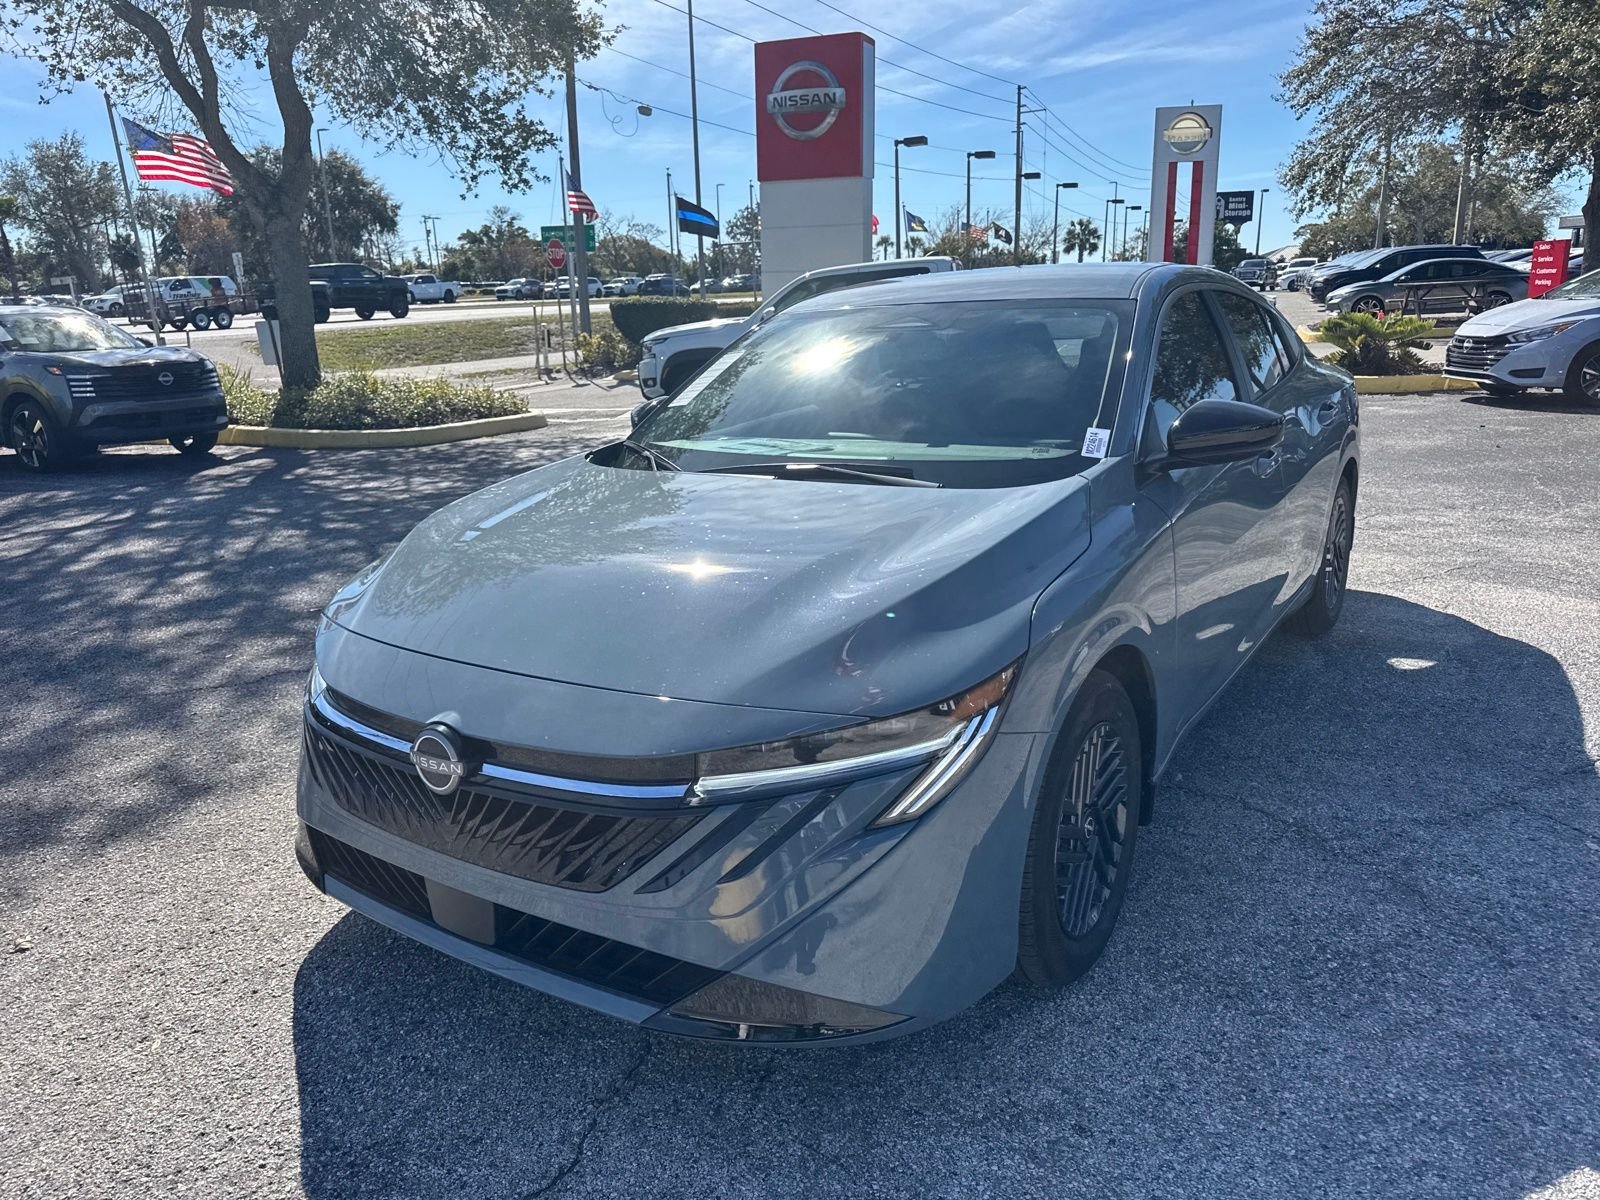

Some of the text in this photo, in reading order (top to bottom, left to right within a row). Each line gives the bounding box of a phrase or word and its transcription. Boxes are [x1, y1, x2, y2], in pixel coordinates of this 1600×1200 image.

[772, 92, 837, 108] NISSAN
[1228, 202, 1249, 210] Mini-
[1224, 209, 1251, 217] Storage
[548, 248, 564, 259] STOP
[1535, 279, 1551, 287] Parking
[410, 751, 461, 774] NISSAN
